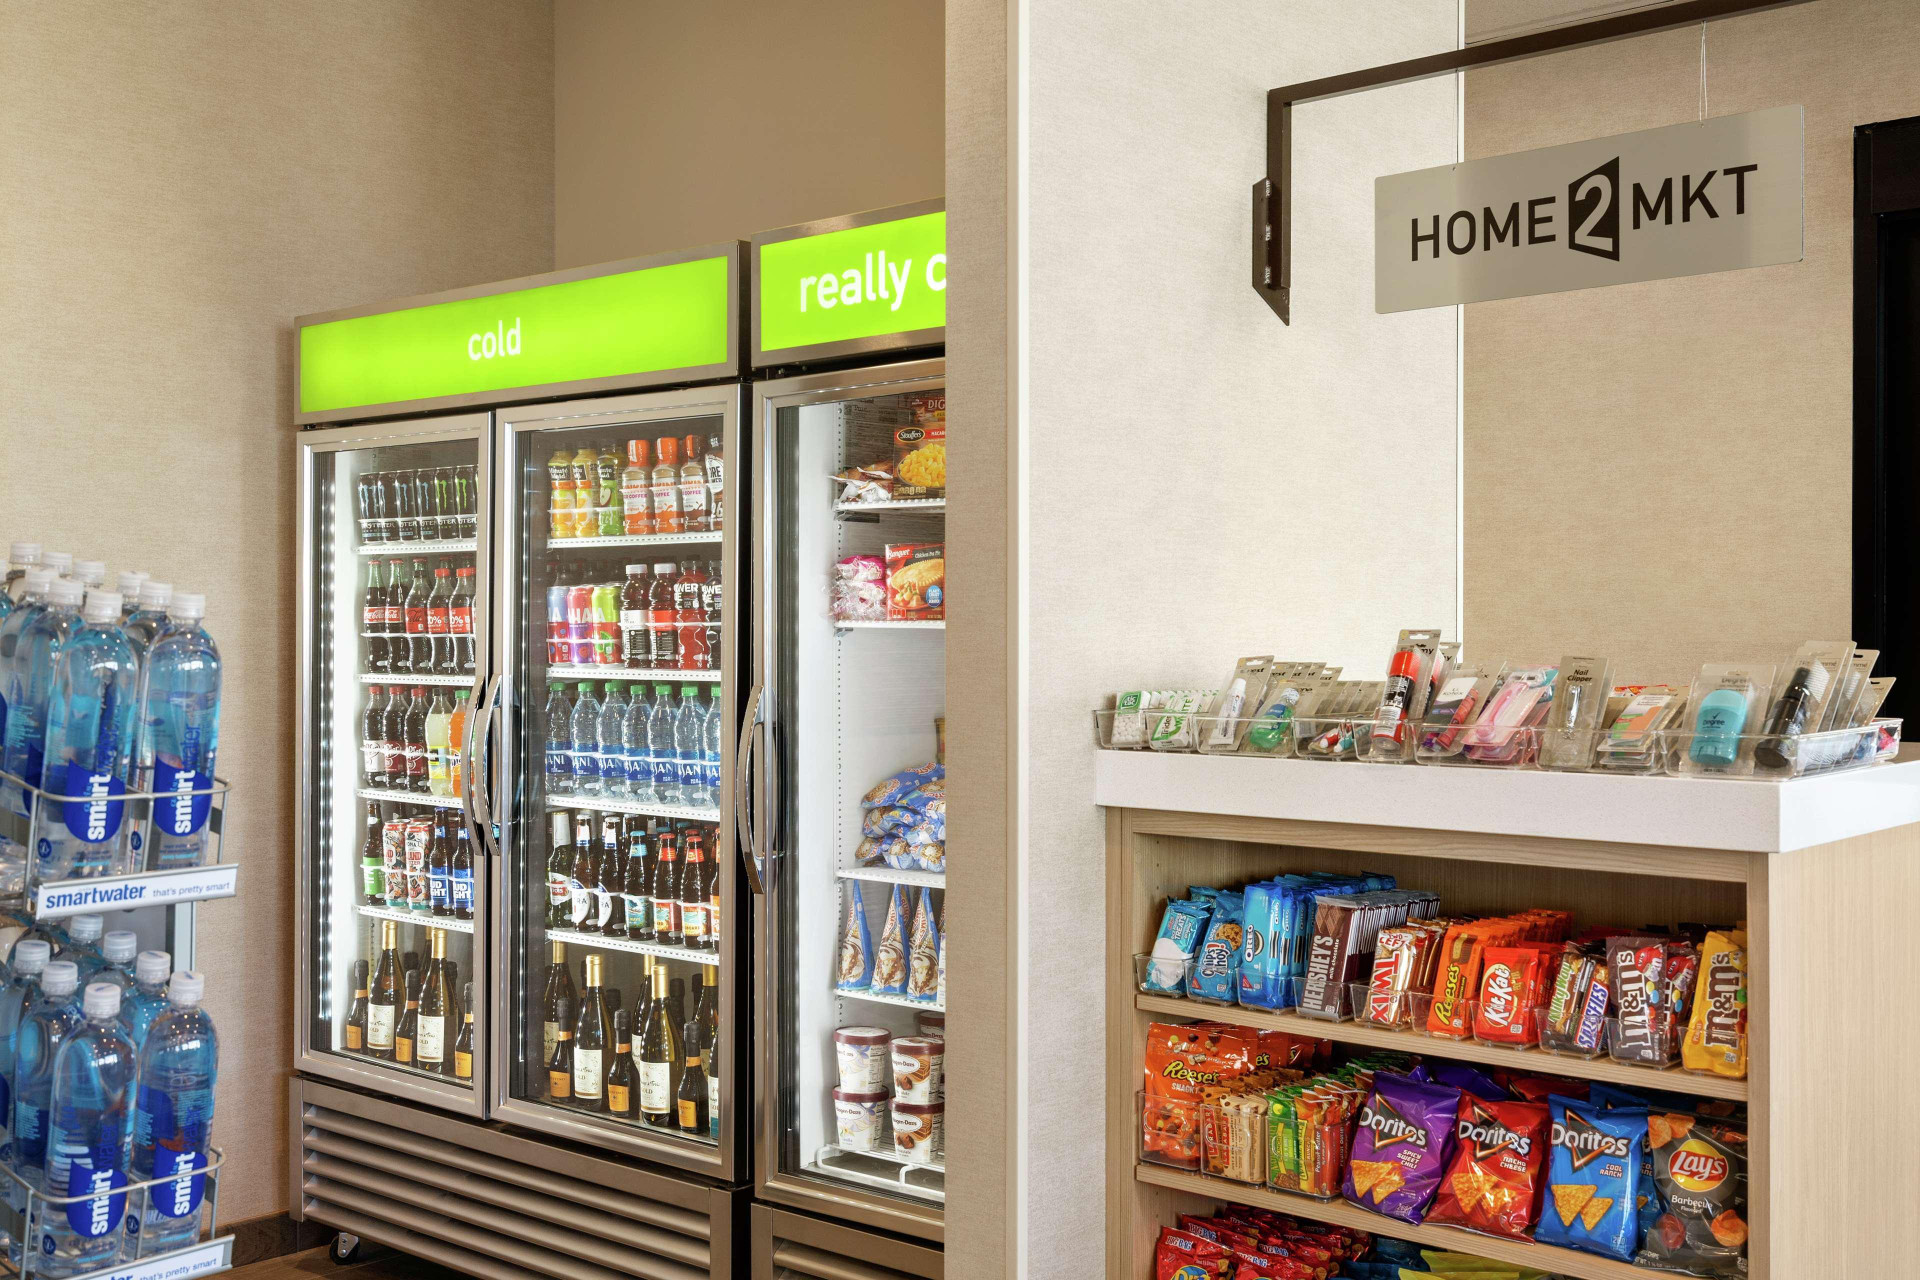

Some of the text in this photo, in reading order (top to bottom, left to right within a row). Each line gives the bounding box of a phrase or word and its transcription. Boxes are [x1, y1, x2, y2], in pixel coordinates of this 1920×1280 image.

[1411, 163, 1758, 262] HOME 2 MKT
[800, 250, 912, 313] really
[467, 317, 521, 361] cold
[45, 882, 230, 909] smartwater that's pretty smart
[1175, 915, 1187, 940] TREATS
[1245, 924, 1254, 962] OREO
[1331, 939, 1340, 965] chocolate
[1379, 936, 1406, 947] LEFT
[1302, 935, 1333, 1010] HERSHEY'S
[1370, 950, 1401, 1024] TWIX
[1434, 963, 1460, 1025] Reese's
[1162, 1060, 1219, 1085] Reese's
[1359, 1107, 1427, 1147] Doritos
[1458, 1120, 1531, 1155] Doritos
[1551, 1124, 1629, 1156] Doritos
[1397, 1153, 1420, 1164] SWEET
[1400, 1160, 1417, 1170] CHILI
[1403, 1149, 1422, 1159] SPICY
[1503, 1155, 1527, 1167] NACHO
[1672, 1151, 1726, 1181] Lay's
[1500, 1161, 1527, 1173] CHEESE
[1600, 1168, 1623, 1178] RANCH
[1605, 1163, 1622, 1172] COOL
[1671, 1194, 1713, 1209] Barbecue
[1178, 1239, 1193, 1251] BAG
[165, 1266, 191, 1279] pretty
[192, 1258, 217, 1270] smart
